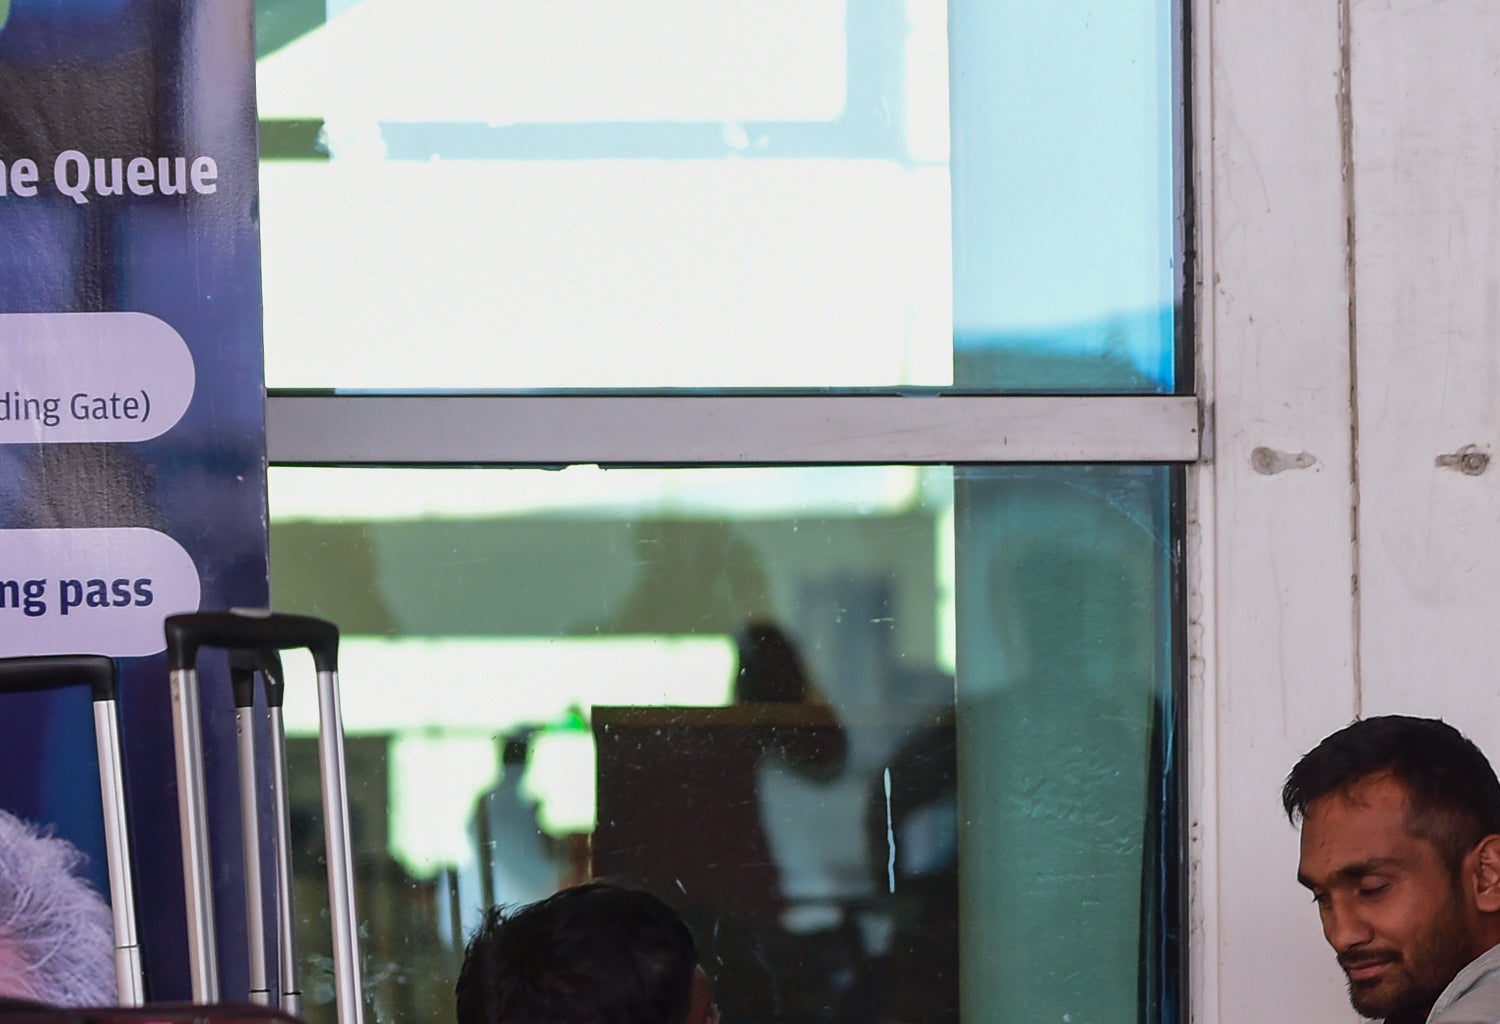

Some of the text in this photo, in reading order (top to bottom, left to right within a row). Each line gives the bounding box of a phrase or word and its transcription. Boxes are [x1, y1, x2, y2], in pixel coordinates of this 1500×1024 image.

[0, 149, 219, 205] e Queue
[70, 389, 151, 423] Gate)
[59, 577, 154, 616] pass
